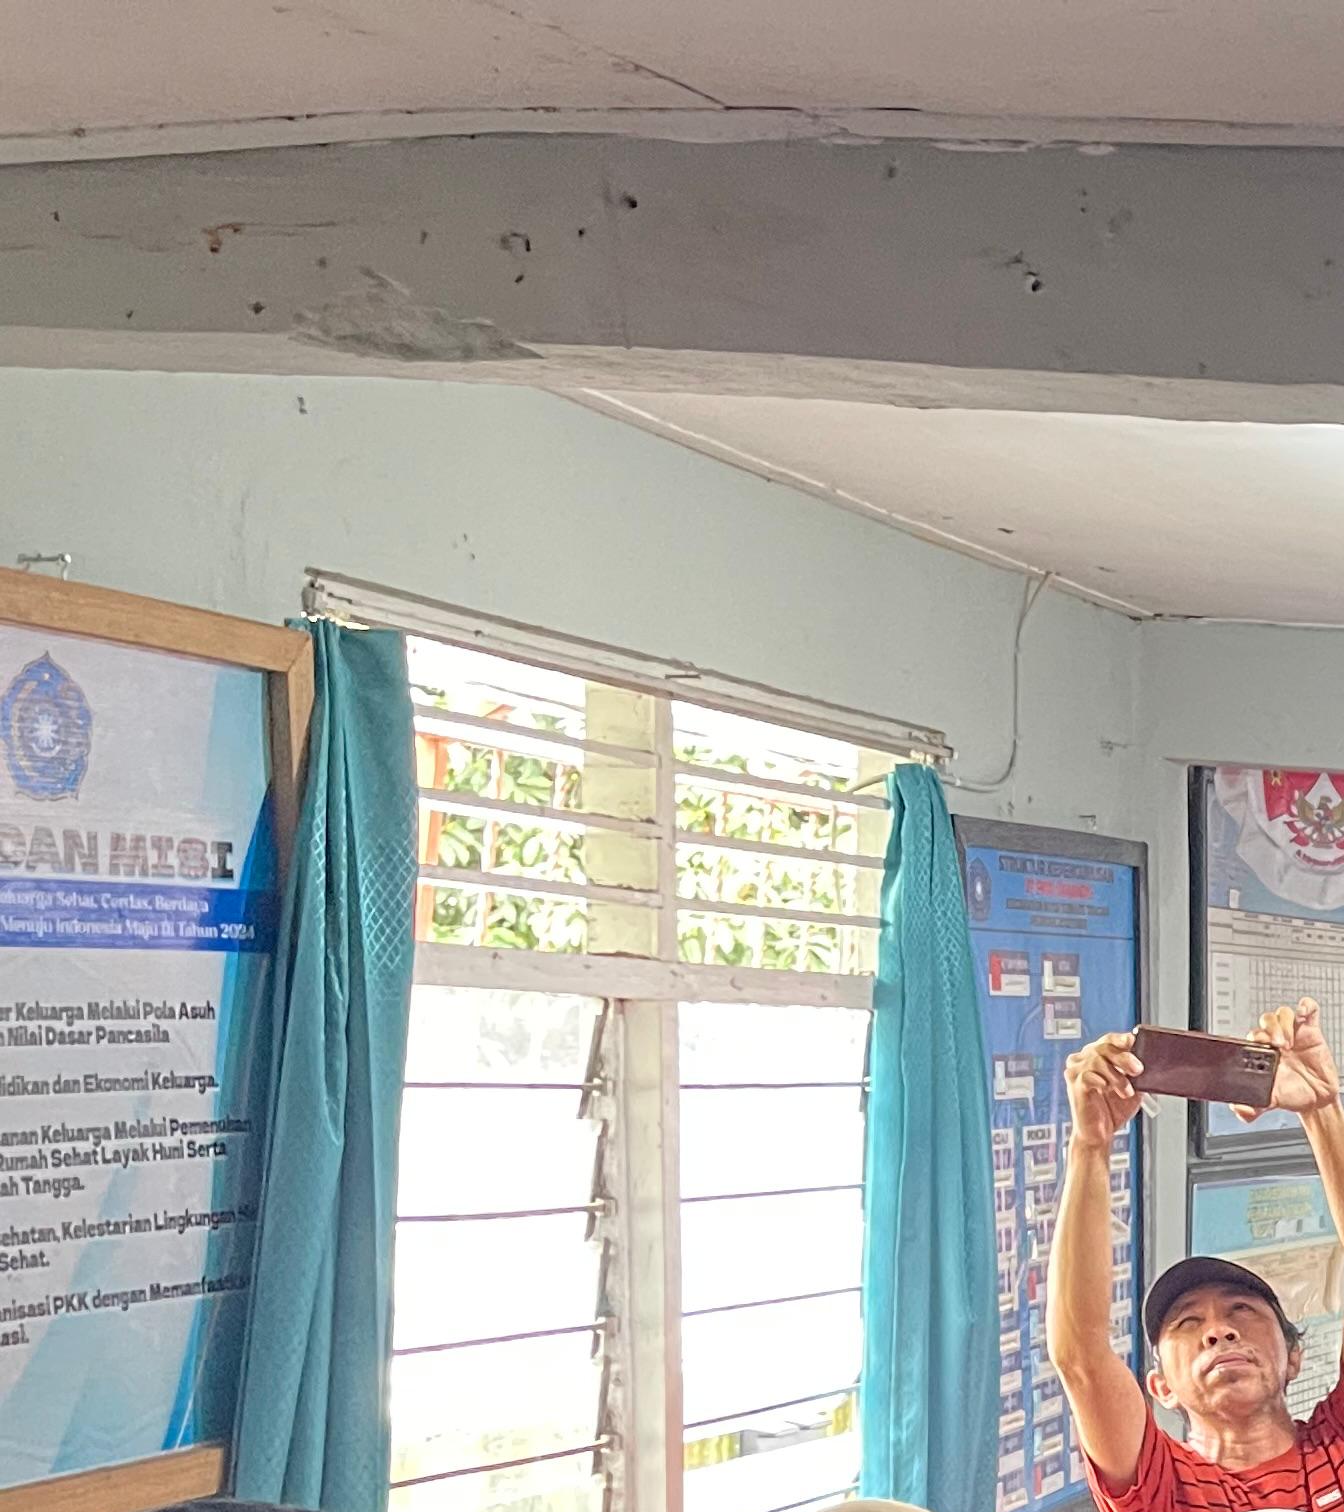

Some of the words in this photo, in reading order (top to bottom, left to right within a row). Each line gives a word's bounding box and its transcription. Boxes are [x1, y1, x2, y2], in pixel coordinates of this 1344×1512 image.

[109, 831, 234, 880] MISI
[16, 1001, 84, 1027] Keluarga
[87, 999, 141, 1020] Melalui
[143, 1000, 176, 1020] Pola
[179, 1000, 216, 1020] Asuh
[8, 1025, 42, 1047] Nilai
[45, 1026, 93, 1046] Dasar
[96, 1023, 170, 1045] Pancasila
[53, 1073, 81, 1094] dan
[83, 1070, 149, 1093] Ekonomi
[151, 1070, 219, 1094] Keluarga.
[41, 1122, 112, 1148] Keluarga
[114, 1116, 167, 1138] Melalui
[51, 1146, 99, 1168] Sehat
[101, 1143, 150, 1169] Layak
[152, 1139, 184, 1161] Huni
[187, 1140, 226, 1158] Serta
[21, 1175, 85, 1199] Tangga.
[62, 1213, 152, 1241] Kelestarian
[154, 1208, 236, 1235] Lingkungan
[53, 1291, 91, 1315] PKK
[92, 1288, 146, 1312] dengan
